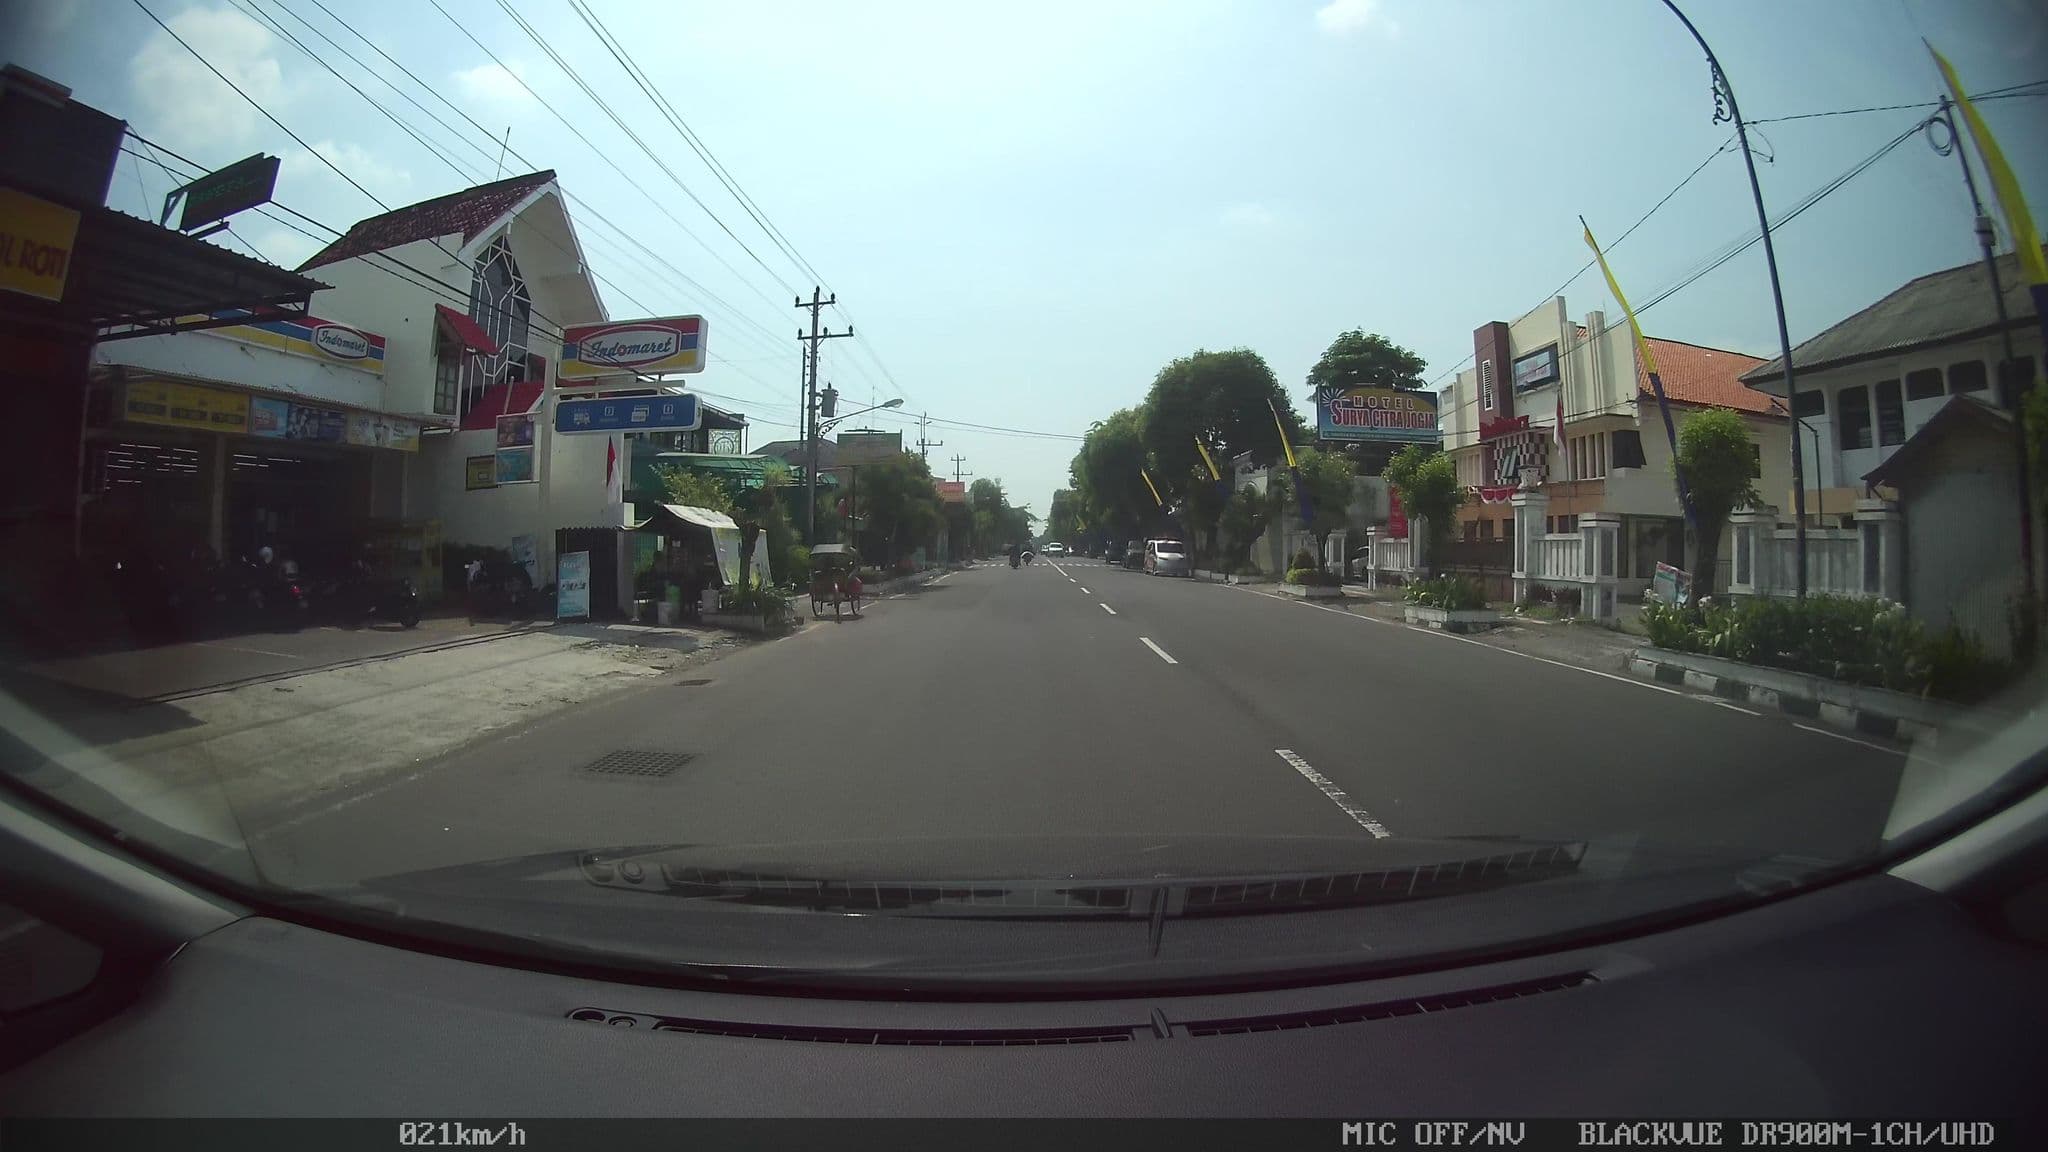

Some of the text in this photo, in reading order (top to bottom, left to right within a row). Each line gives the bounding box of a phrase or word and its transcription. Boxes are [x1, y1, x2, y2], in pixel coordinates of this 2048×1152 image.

[19, 240, 68, 280] ROTI
[319, 330, 366, 353] Indomaret
[589, 336, 672, 359] Indomaret
[1330, 398, 1436, 430] SURYA CITRA JOGJA
[1353, 395, 1414, 410] HOTEL
